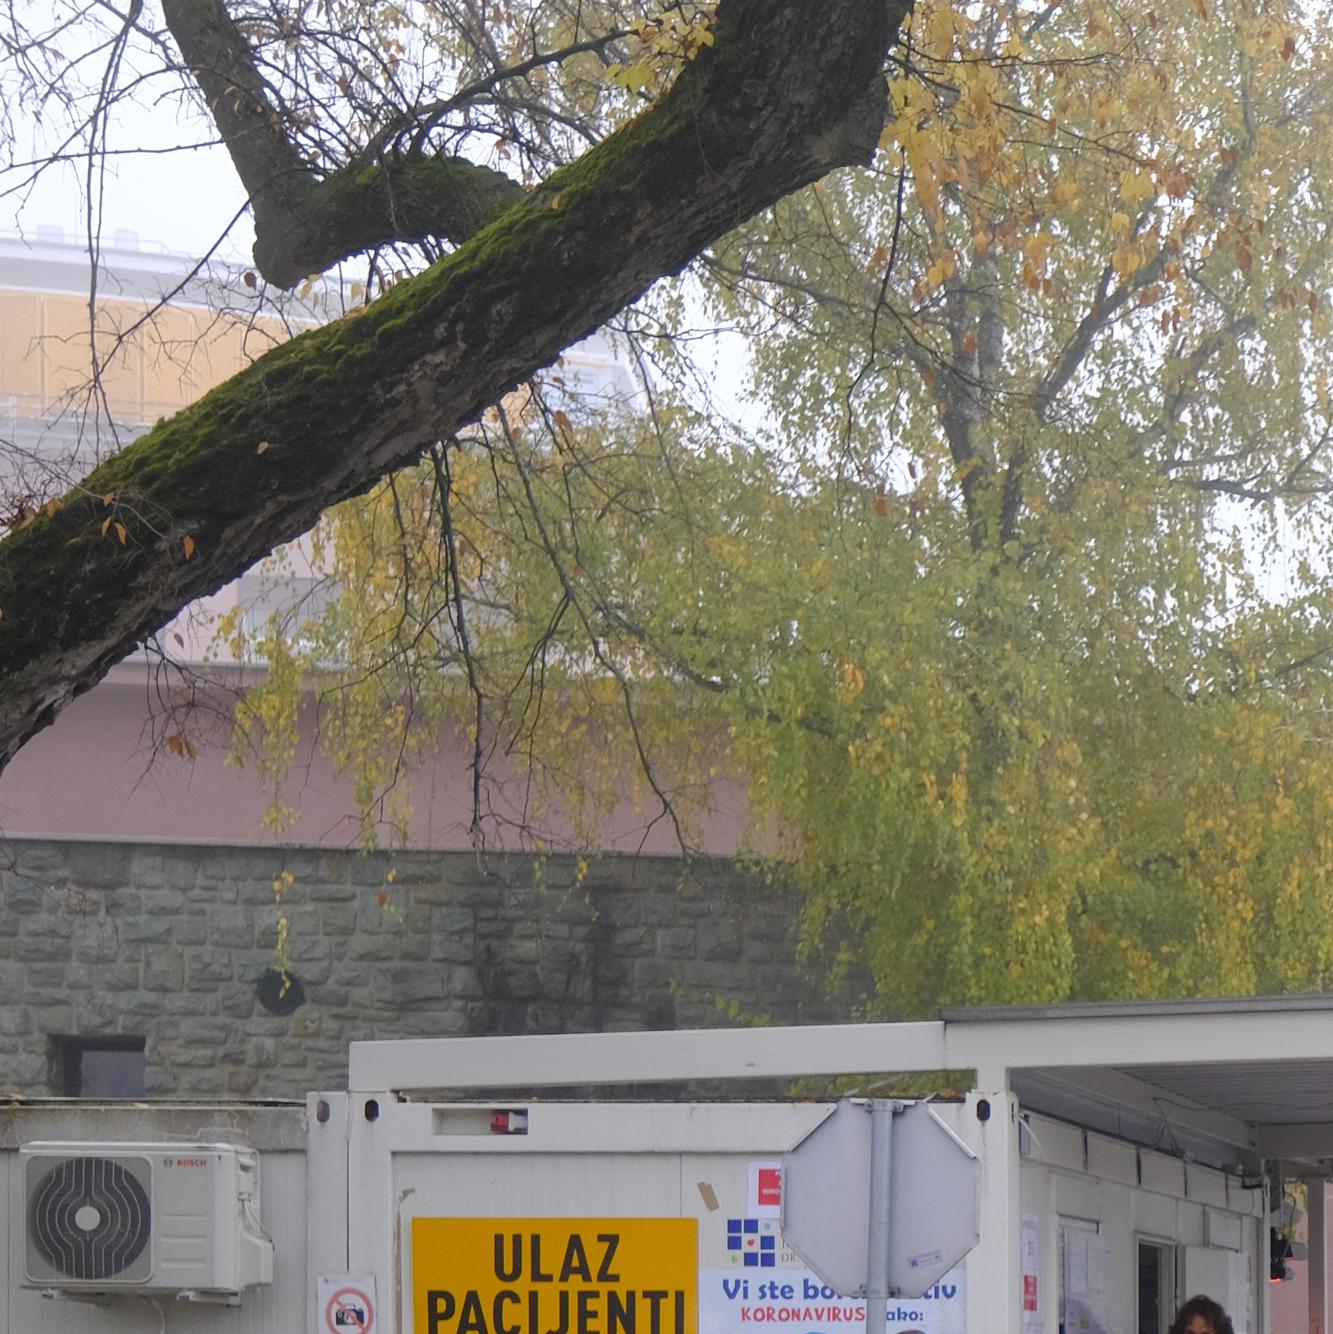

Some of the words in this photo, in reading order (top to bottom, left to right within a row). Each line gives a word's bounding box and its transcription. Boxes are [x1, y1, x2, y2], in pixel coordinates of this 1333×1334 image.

[494, 1233, 620, 1282] ULAZ
[722, 1279, 749, 1299] Vi
[758, 1281, 794, 1300] ste
